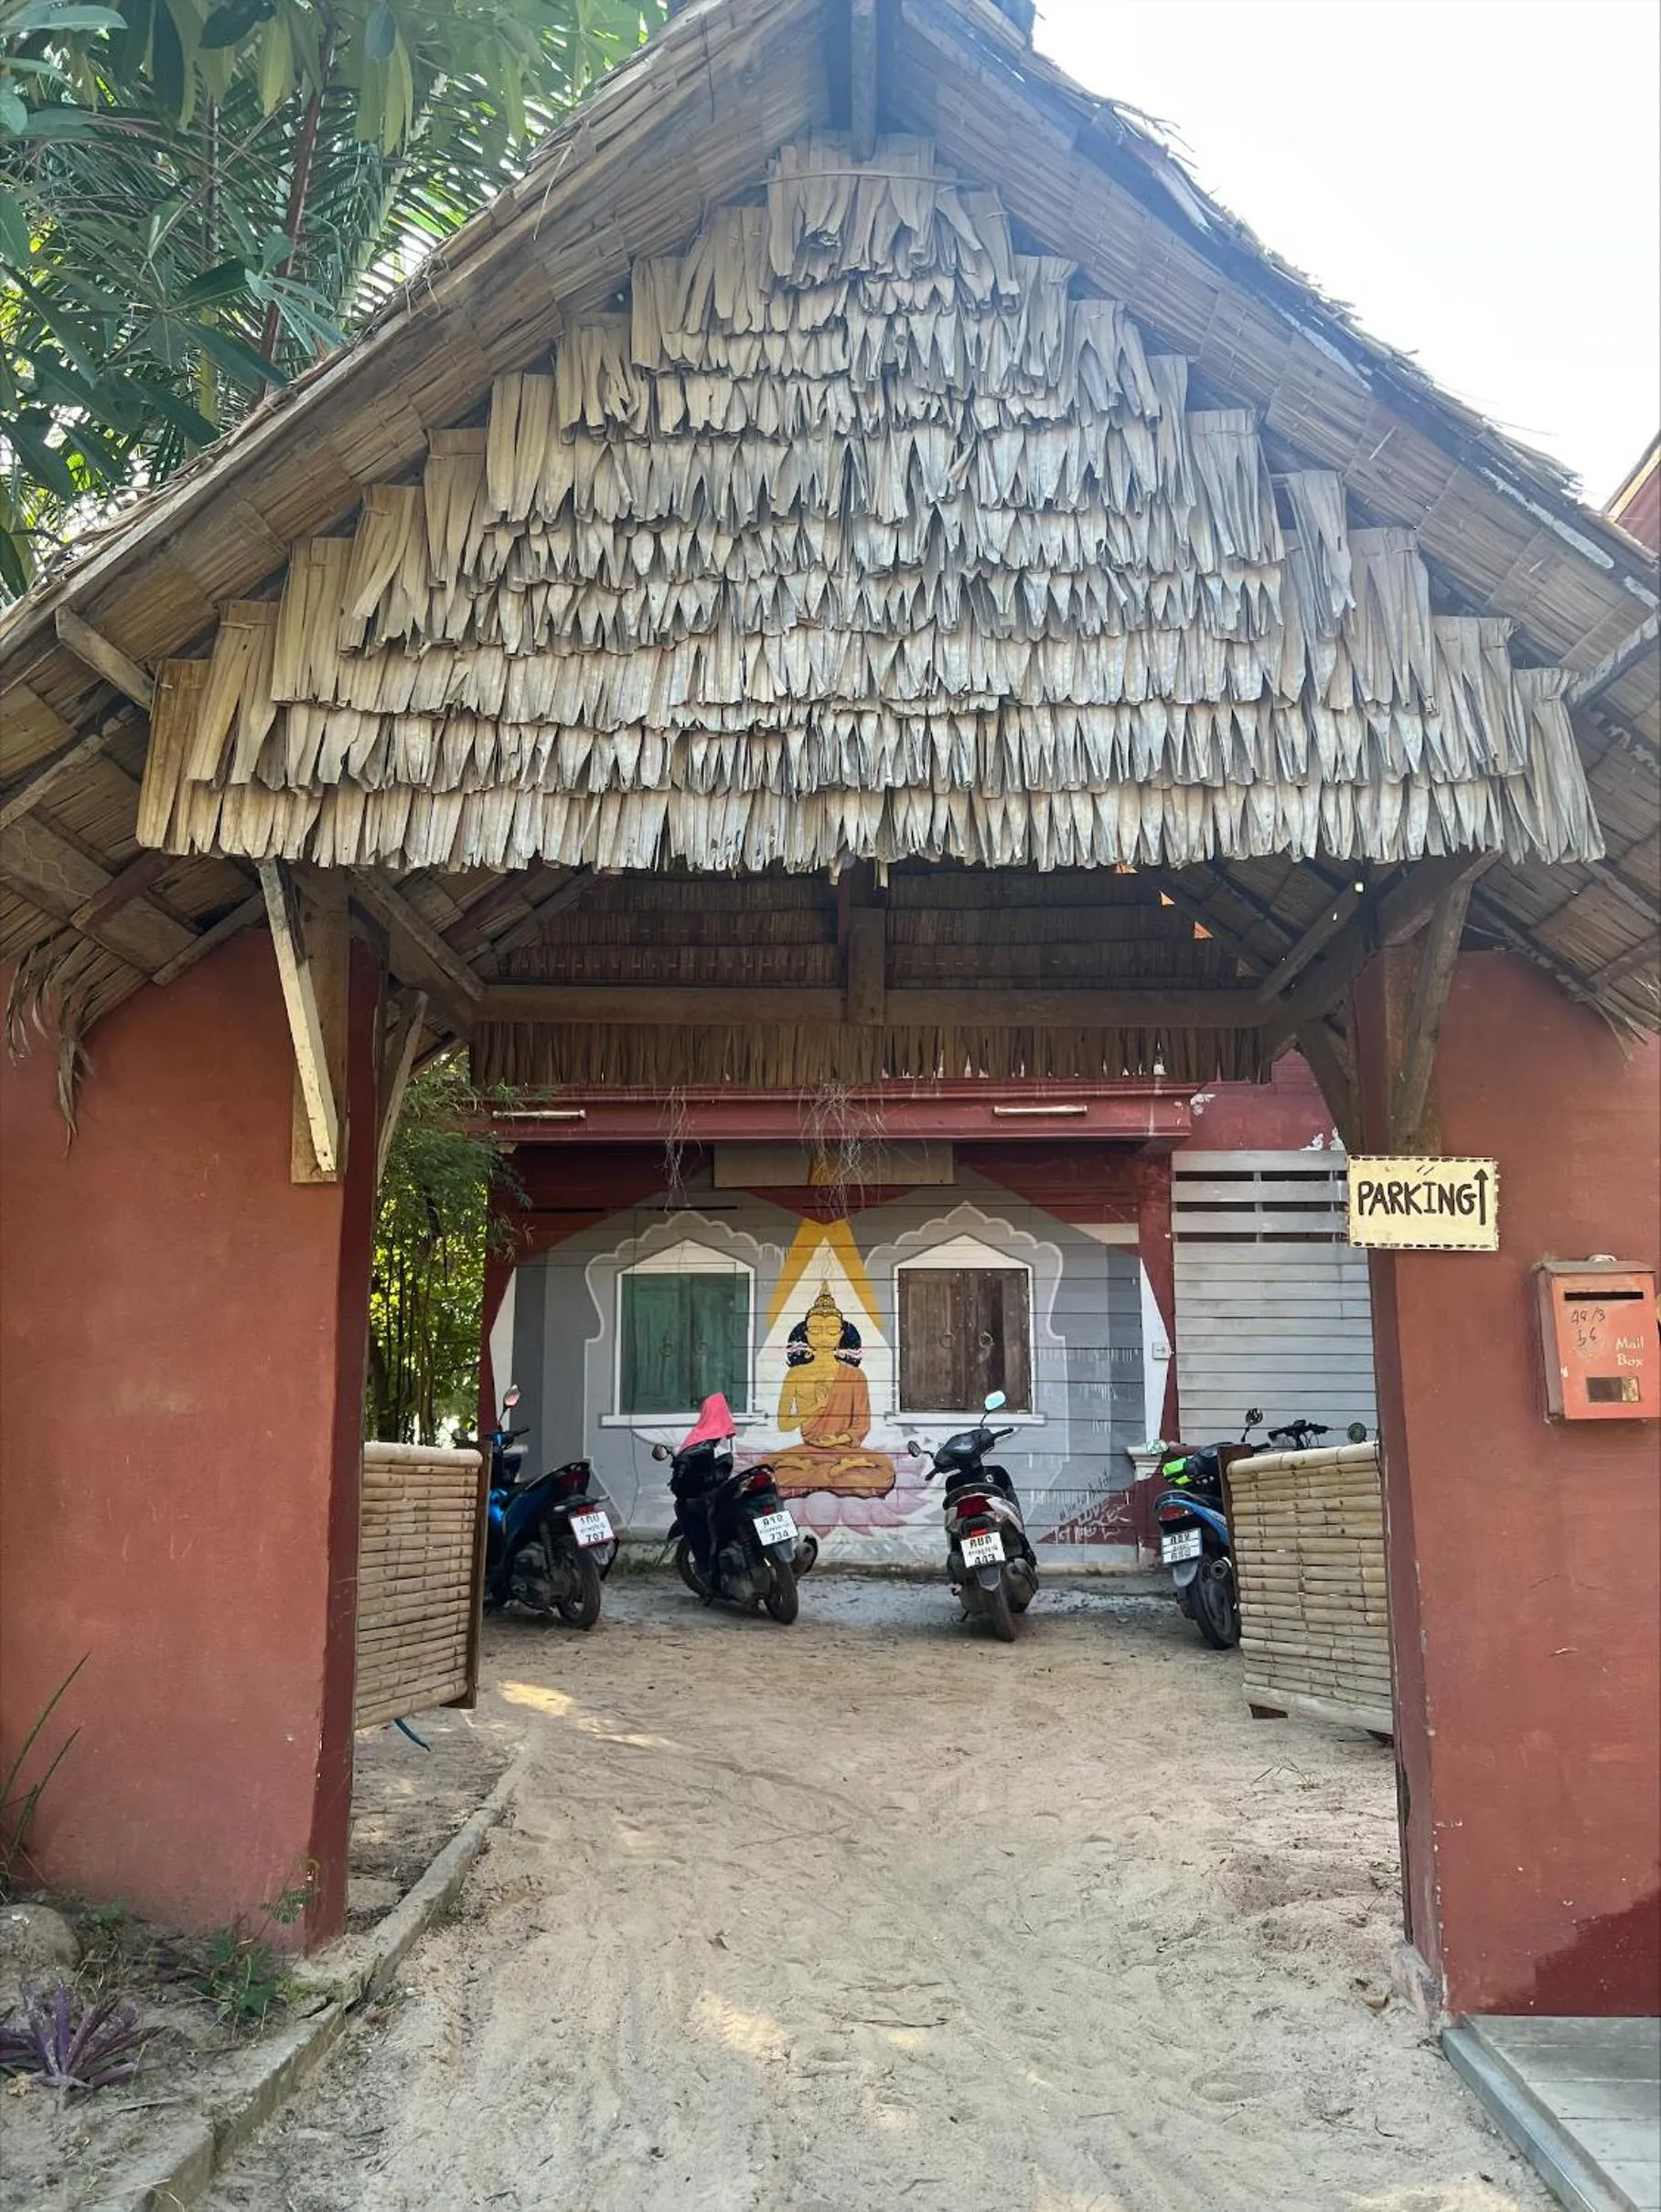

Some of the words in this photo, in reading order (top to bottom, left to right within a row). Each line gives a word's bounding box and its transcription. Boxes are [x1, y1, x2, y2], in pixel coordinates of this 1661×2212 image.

[1356, 1180, 1478, 1216] PARKING
[1615, 1335, 1645, 1352] Mail
[1615, 1352, 1645, 1368] Box
